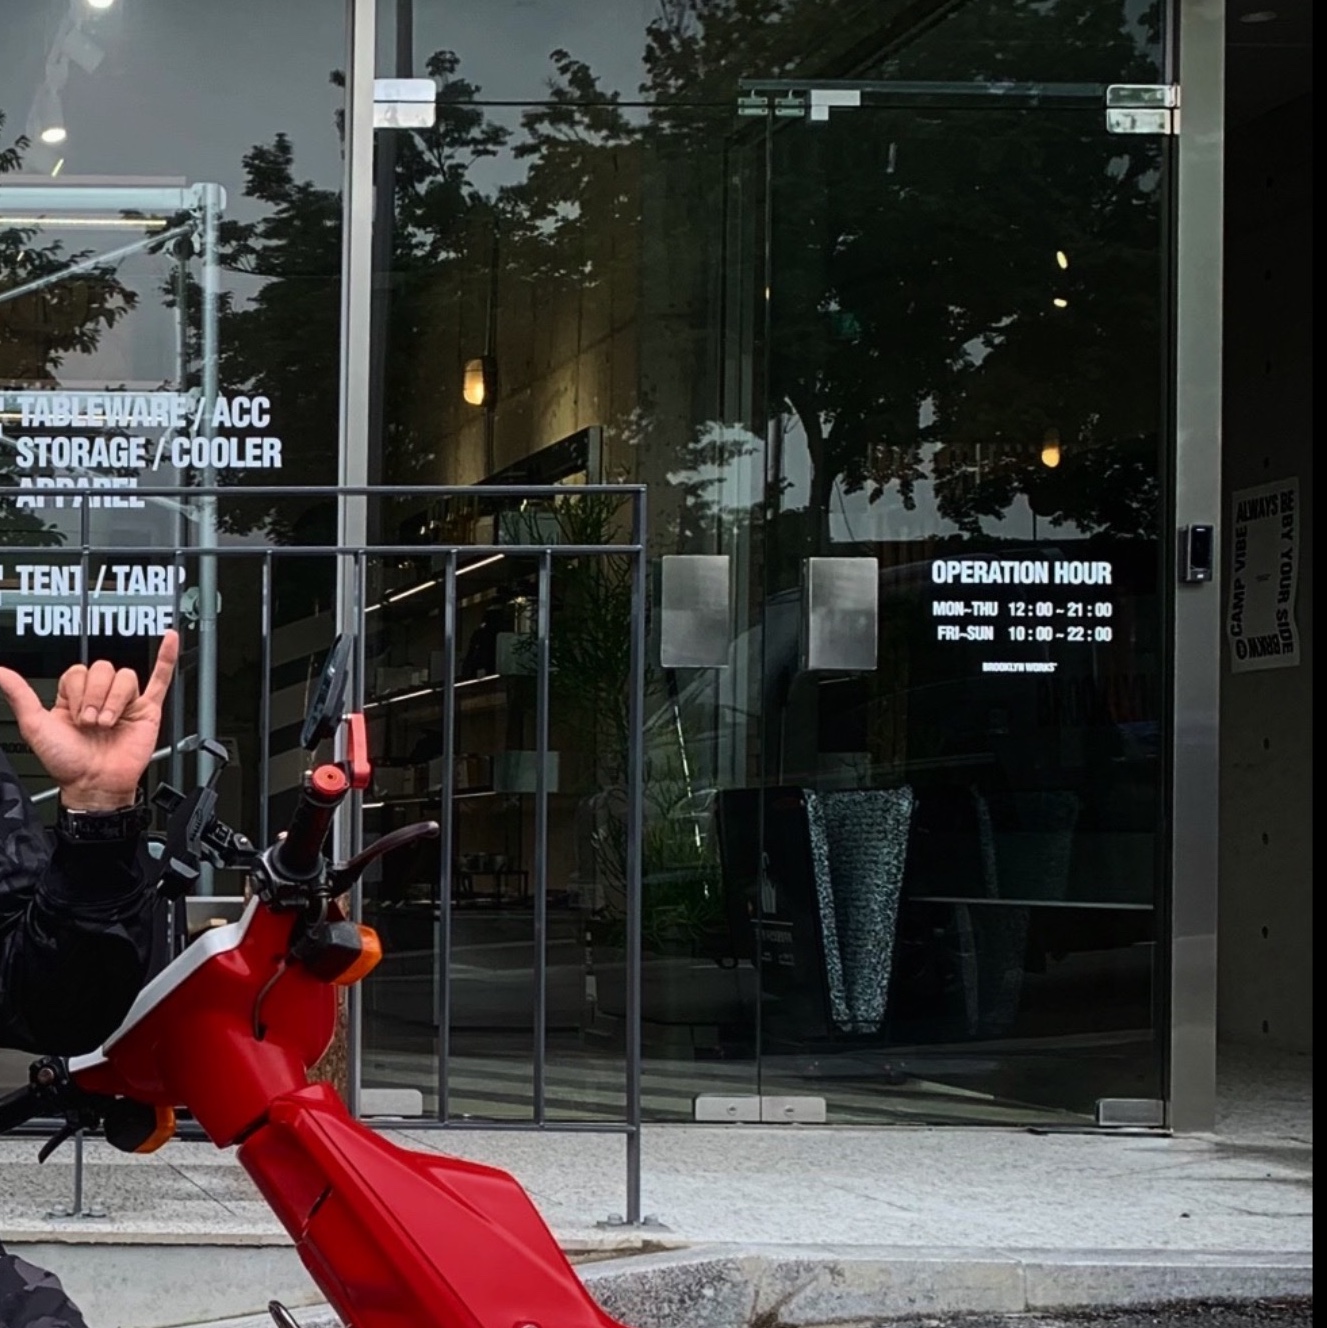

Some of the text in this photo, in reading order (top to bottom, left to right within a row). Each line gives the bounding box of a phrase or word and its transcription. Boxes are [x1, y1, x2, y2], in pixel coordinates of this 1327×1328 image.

[16, 396, 187, 428] TABLEWARE
[212, 396, 271, 428] ACC
[16, 436, 146, 468] STORAGE
[171, 436, 283, 468] COOLER
[15, 477, 146, 508] APPAREL
[1235, 493, 1278, 524] ALWAYS
[16, 565, 85, 596] TENT
[112, 565, 186, 596] TARP
[931, 560, 1113, 585] OPERATION HOUR
[1230, 525, 1248, 637] CAMP VIBE
[1275, 513, 1294, 655] BY YOUR SIDE
[16, 605, 174, 636] FURNITURE
[982, 662, 1024, 672] BROOKLYN
